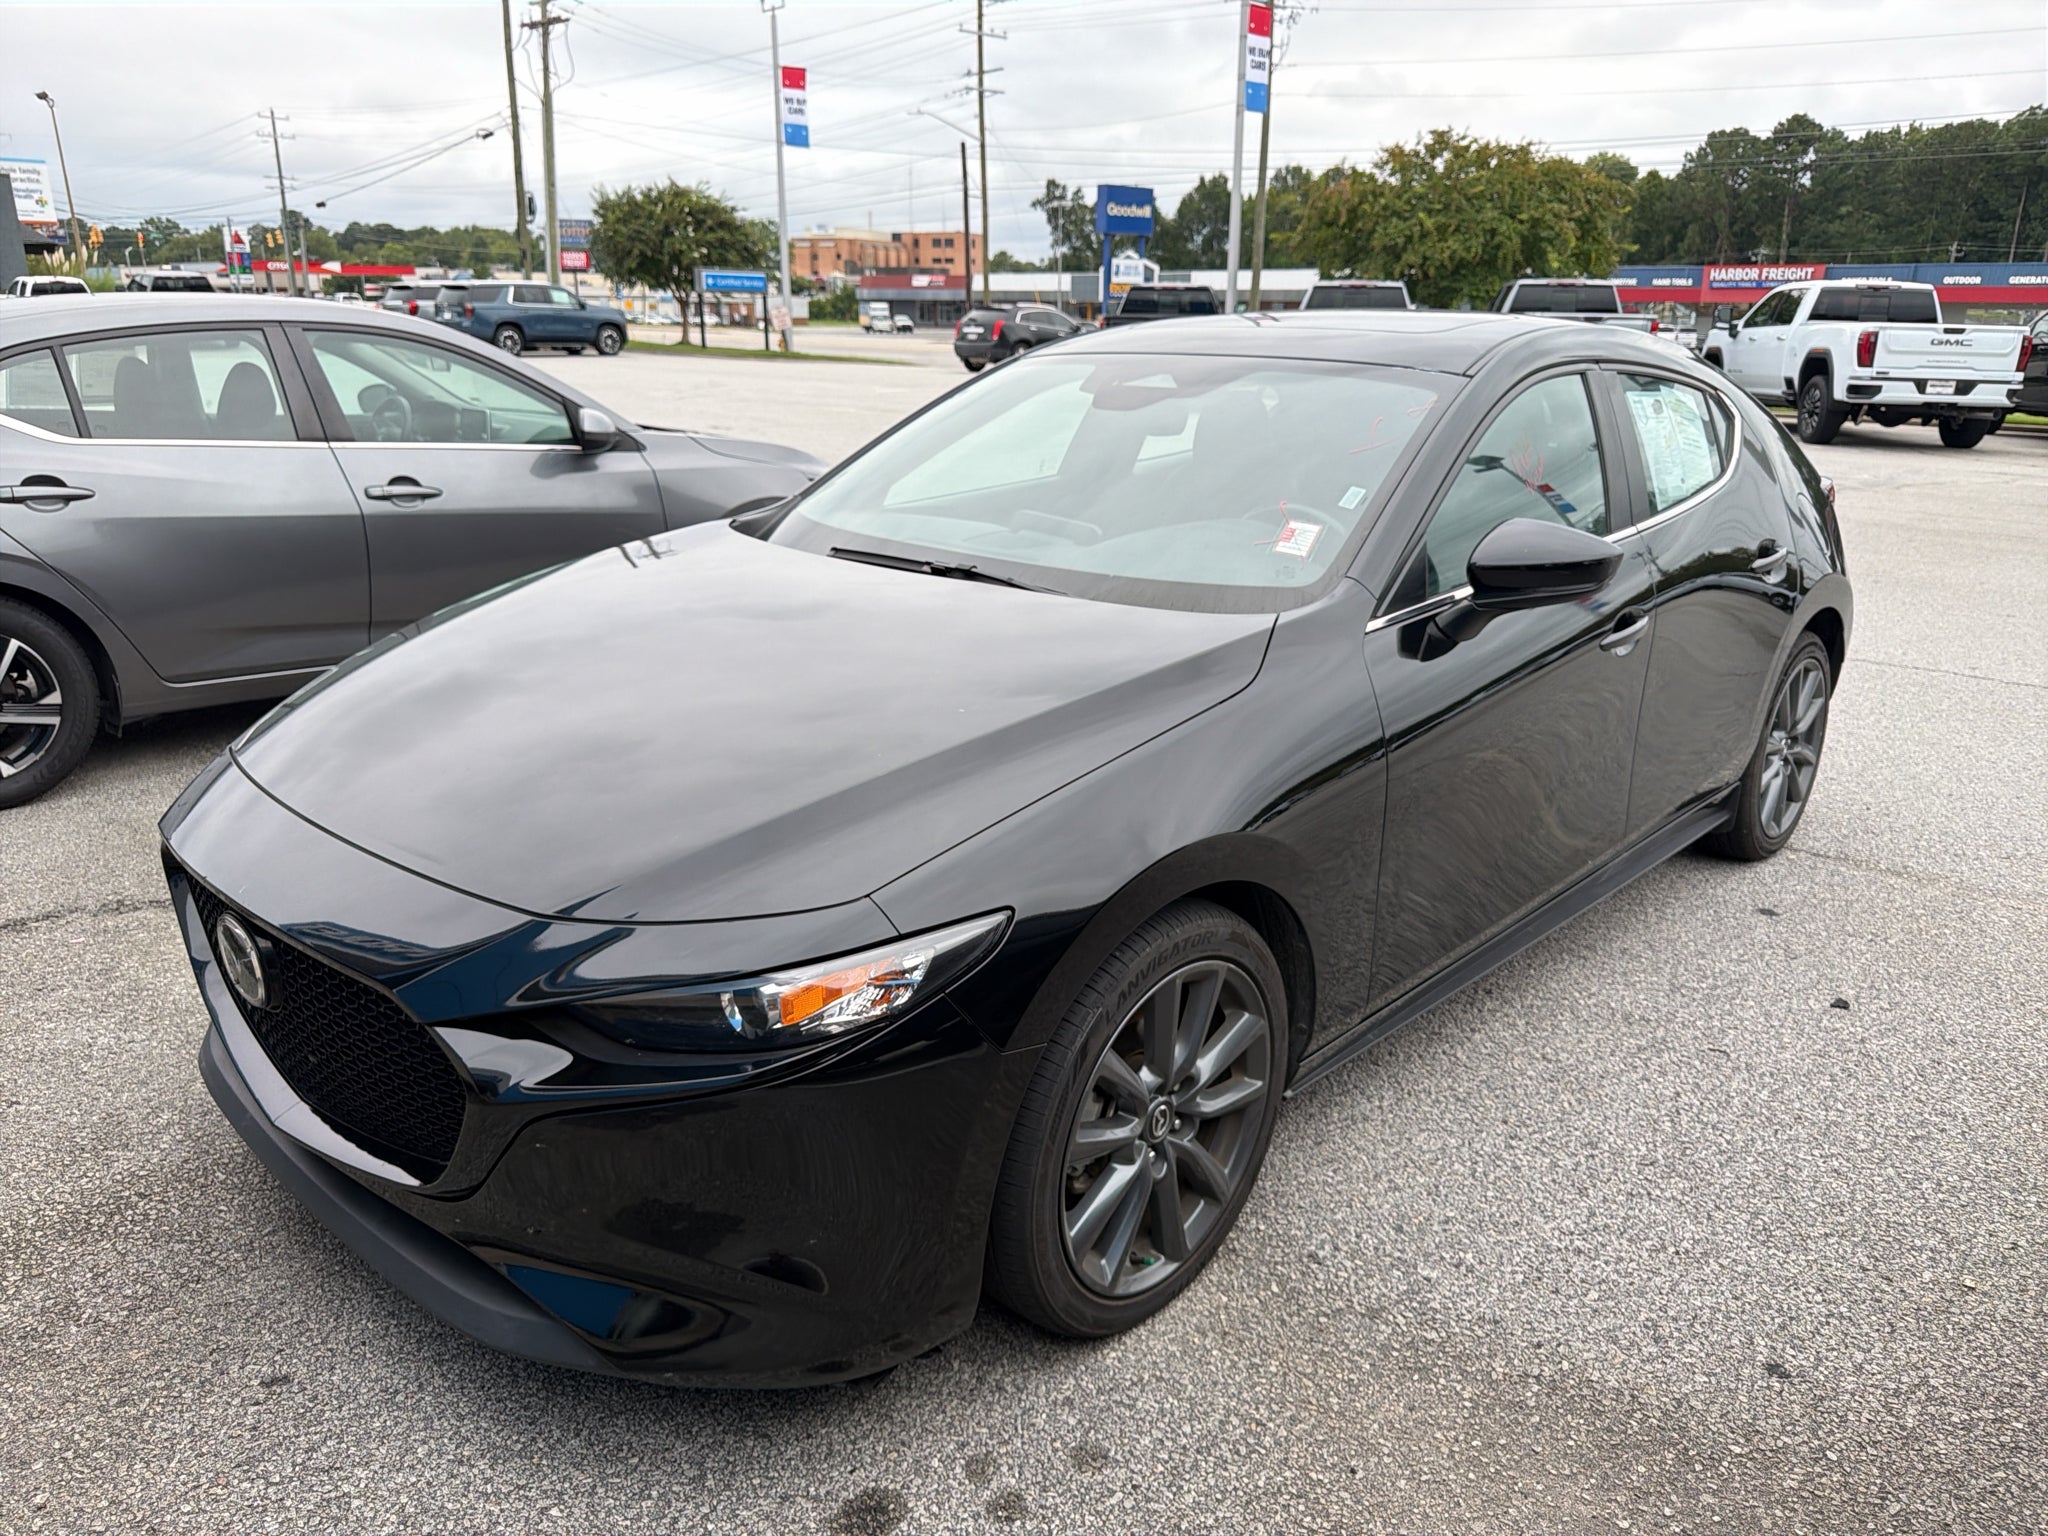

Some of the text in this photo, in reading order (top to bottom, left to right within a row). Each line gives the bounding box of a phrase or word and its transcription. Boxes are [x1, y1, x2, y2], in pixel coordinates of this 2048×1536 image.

[1107, 202, 1152, 218] Goodwill
[1710, 267, 1815, 280] HARBOR FREIGHT
[1943, 276, 1982, 285] OUTDOOR
[1930, 338, 1973, 347] GMC
[1105, 930, 1216, 1025] LANVIGATOR
